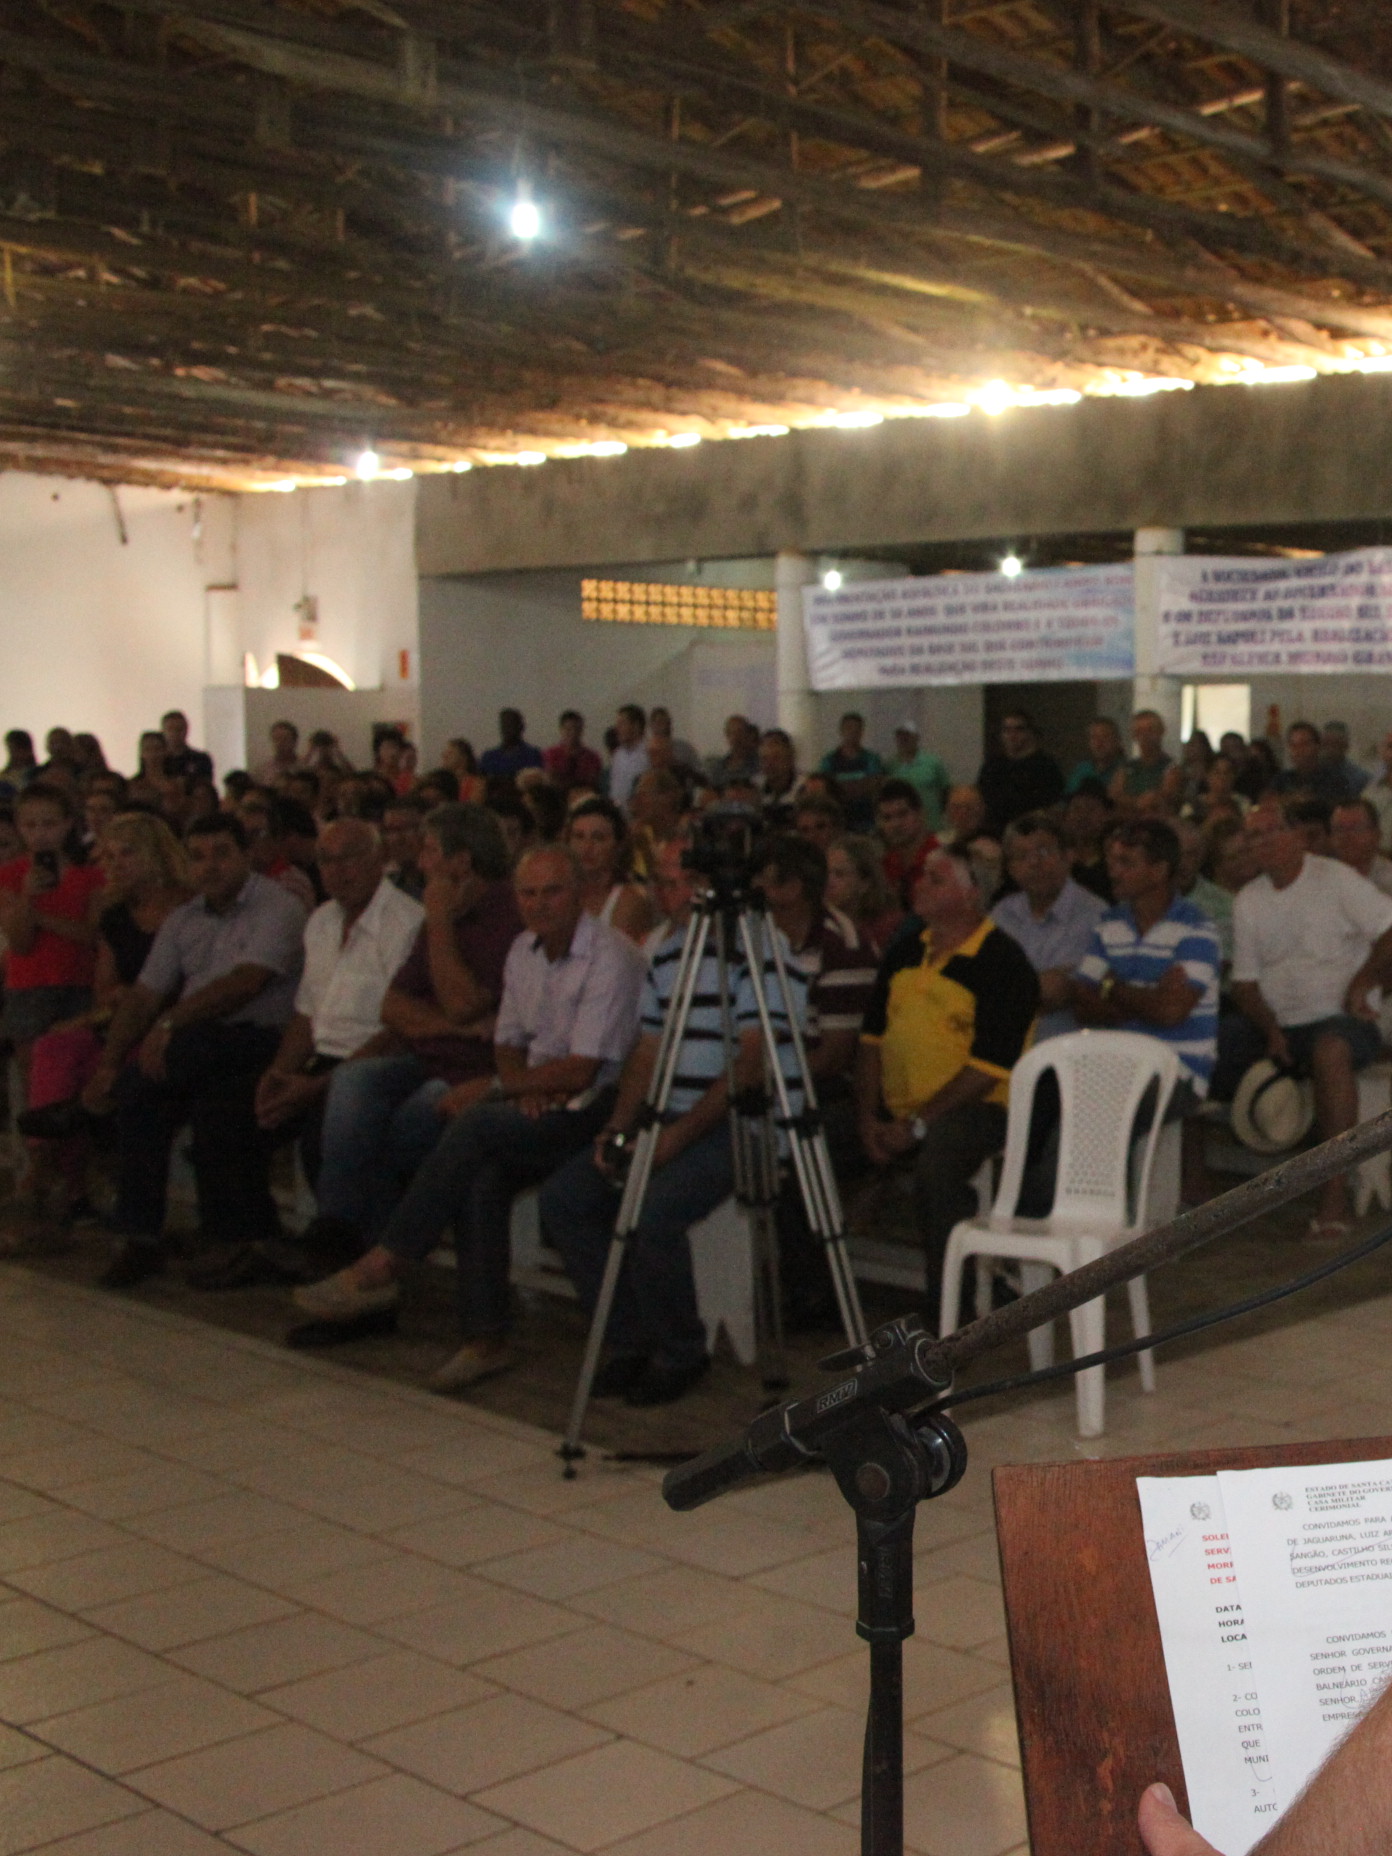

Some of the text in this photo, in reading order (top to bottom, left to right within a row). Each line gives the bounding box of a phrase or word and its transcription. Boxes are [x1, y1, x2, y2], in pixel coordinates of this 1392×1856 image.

[1302, 1518, 1361, 1531] CONVIDAMOS
[1364, 1516, 1386, 1524] PARA
[1287, 1538, 1299, 1546] DE
[1303, 1533, 1356, 1546] JAGUARUNA,
[1360, 1530, 1379, 1539] LUIZ
[1290, 1549, 1328, 1561] SANGÃO,
[1331, 1545, 1374, 1556] CASTILHO
[1292, 1559, 1378, 1575] DESENVOLVIMENTO
[1295, 1577, 1348, 1589] DEPUTADOS
[1215, 1604, 1242, 1614] DATA
[1326, 1631, 1387, 1644] CONVIDAMOS
[1310, 1651, 1347, 1661] SENHOR
[1313, 1666, 1346, 1676] ORDEM
[1351, 1664, 1362, 1672] DE
[1316, 1678, 1367, 1691] BALNEÁRIO
[1319, 1696, 1356, 1706] SENHOR
[1241, 1739, 1261, 1750] QUE
